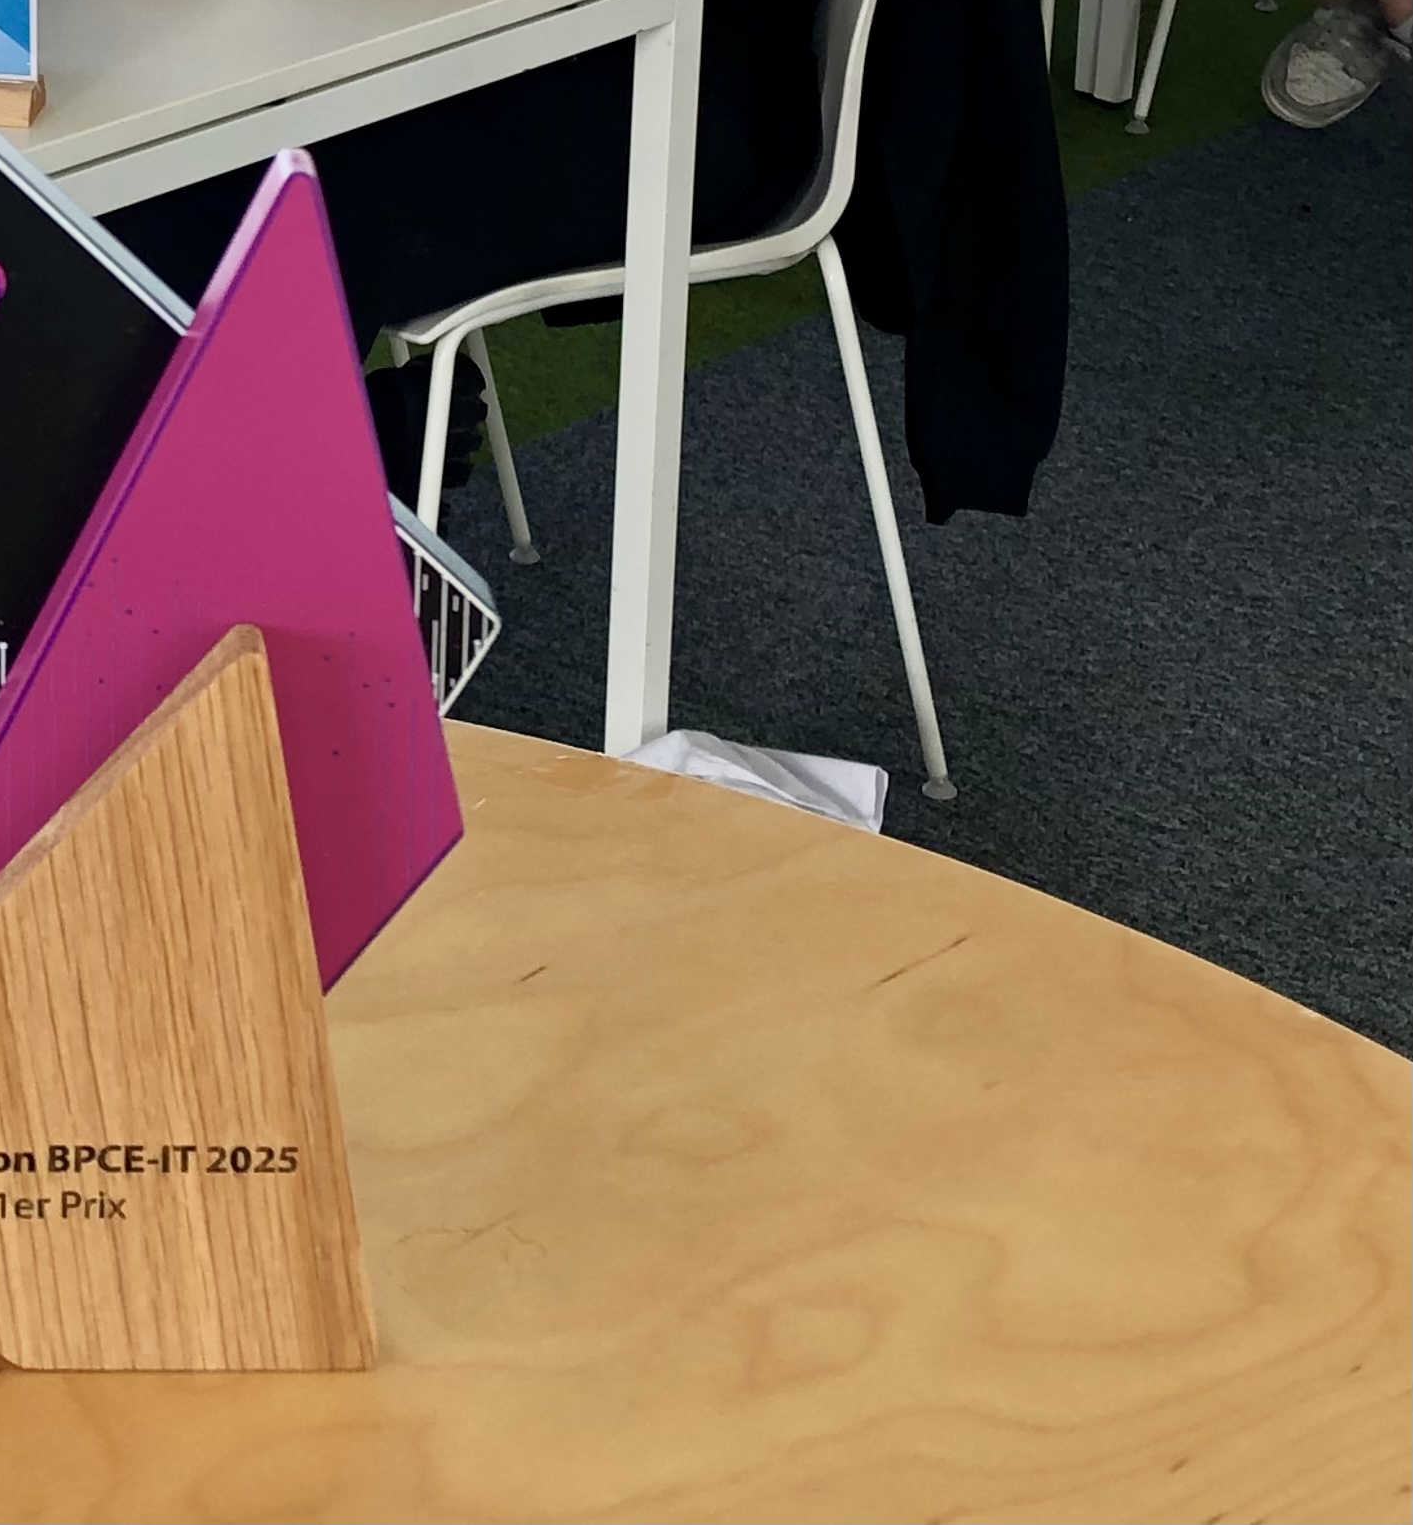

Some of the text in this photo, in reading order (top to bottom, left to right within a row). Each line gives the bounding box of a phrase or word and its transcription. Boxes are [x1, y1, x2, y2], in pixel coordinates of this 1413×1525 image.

[47, 1144, 196, 1174] BPCE-IT
[205, 1145, 299, 1174] 2025
[60, 1190, 126, 1221] Prix
